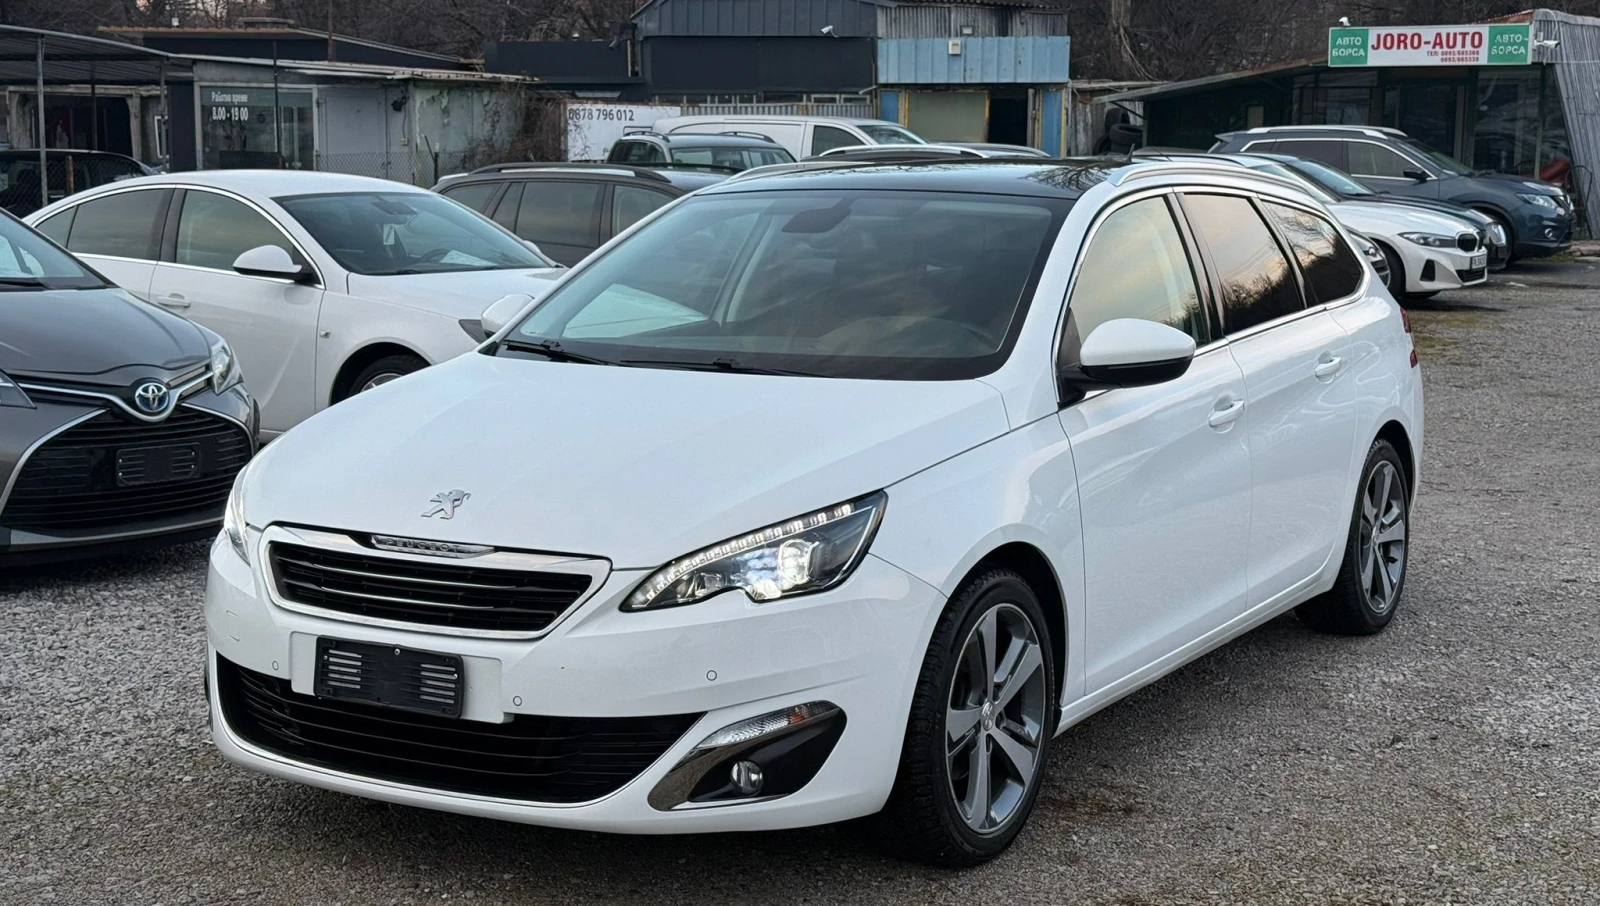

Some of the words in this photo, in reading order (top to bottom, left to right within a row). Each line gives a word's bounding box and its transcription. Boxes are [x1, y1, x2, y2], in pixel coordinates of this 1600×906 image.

[1336, 37, 1362, 46] АВТО
[1371, 31, 1483, 51] JORO-AUTO
[1332, 48, 1365, 57] БОРСА
[1491, 46, 1526, 55] БОРСА
[568, 108, 594, 120] 0878
[596, 109, 614, 120] 796
[616, 109, 634, 121] 012
[386, 537, 460, 554] PEUGEOT
